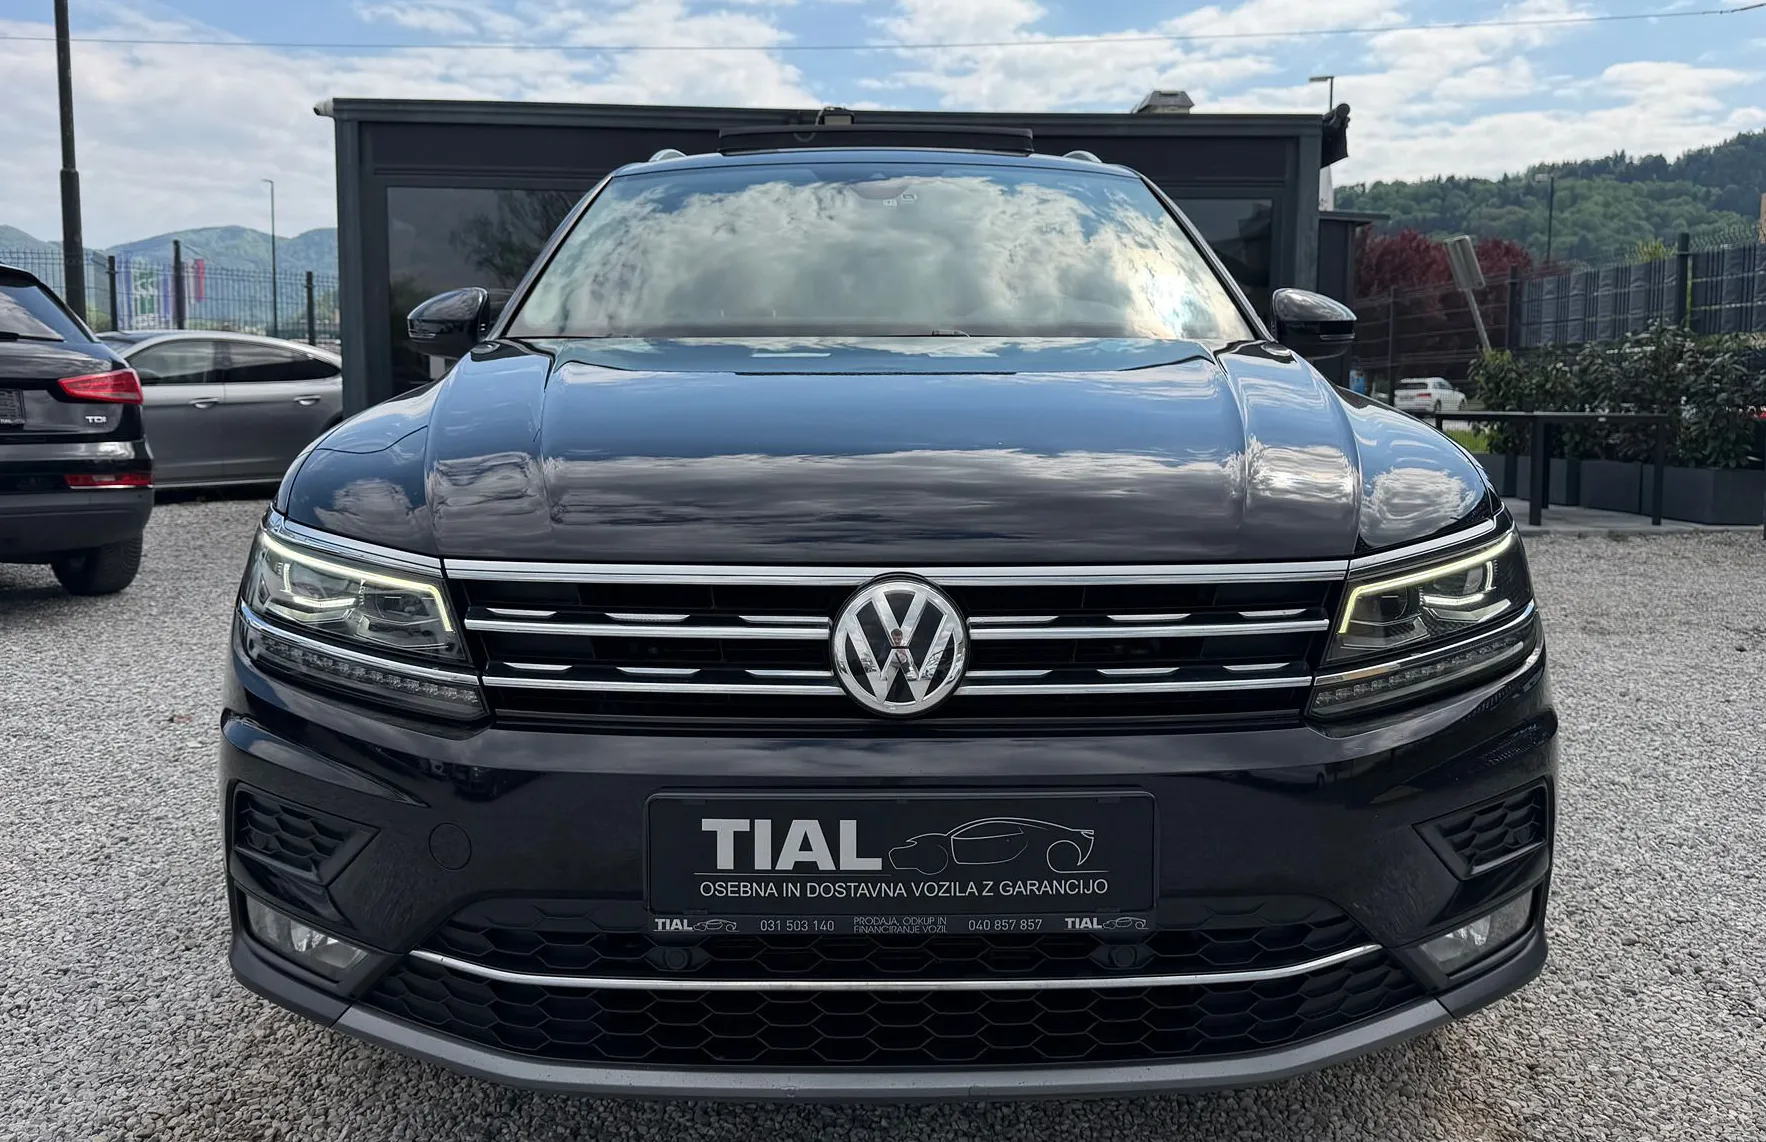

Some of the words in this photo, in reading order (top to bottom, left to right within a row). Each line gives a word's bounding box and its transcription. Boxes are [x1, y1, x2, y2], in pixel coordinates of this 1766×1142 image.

[701, 818, 883, 871] TIAL
[700, 881, 778, 897] OSEBNA
[783, 882, 800, 897] IN
[806, 882, 907, 898] DOSTAVNA
[911, 881, 978, 897] VOZILA
[982, 881, 994, 896] Z
[999, 879, 1109, 896] GARANCIJO
[654, 918, 693, 931] TIAL
[760, 919, 781, 931] 031
[786, 919, 809, 931] 503
[813, 920, 835, 931] 140
[853, 916, 900, 926] PRODAJA,
[903, 916, 935, 925] ODKUP
[937, 916, 947, 925] IN
[968, 919, 991, 931] 040
[994, 919, 1016, 931] 857
[1020, 919, 1043, 930] 857
[1064, 917, 1103, 929] TIAL
[853, 925, 920, 934] FINANCIRANJE
[922, 925, 947, 933] VOZIL
